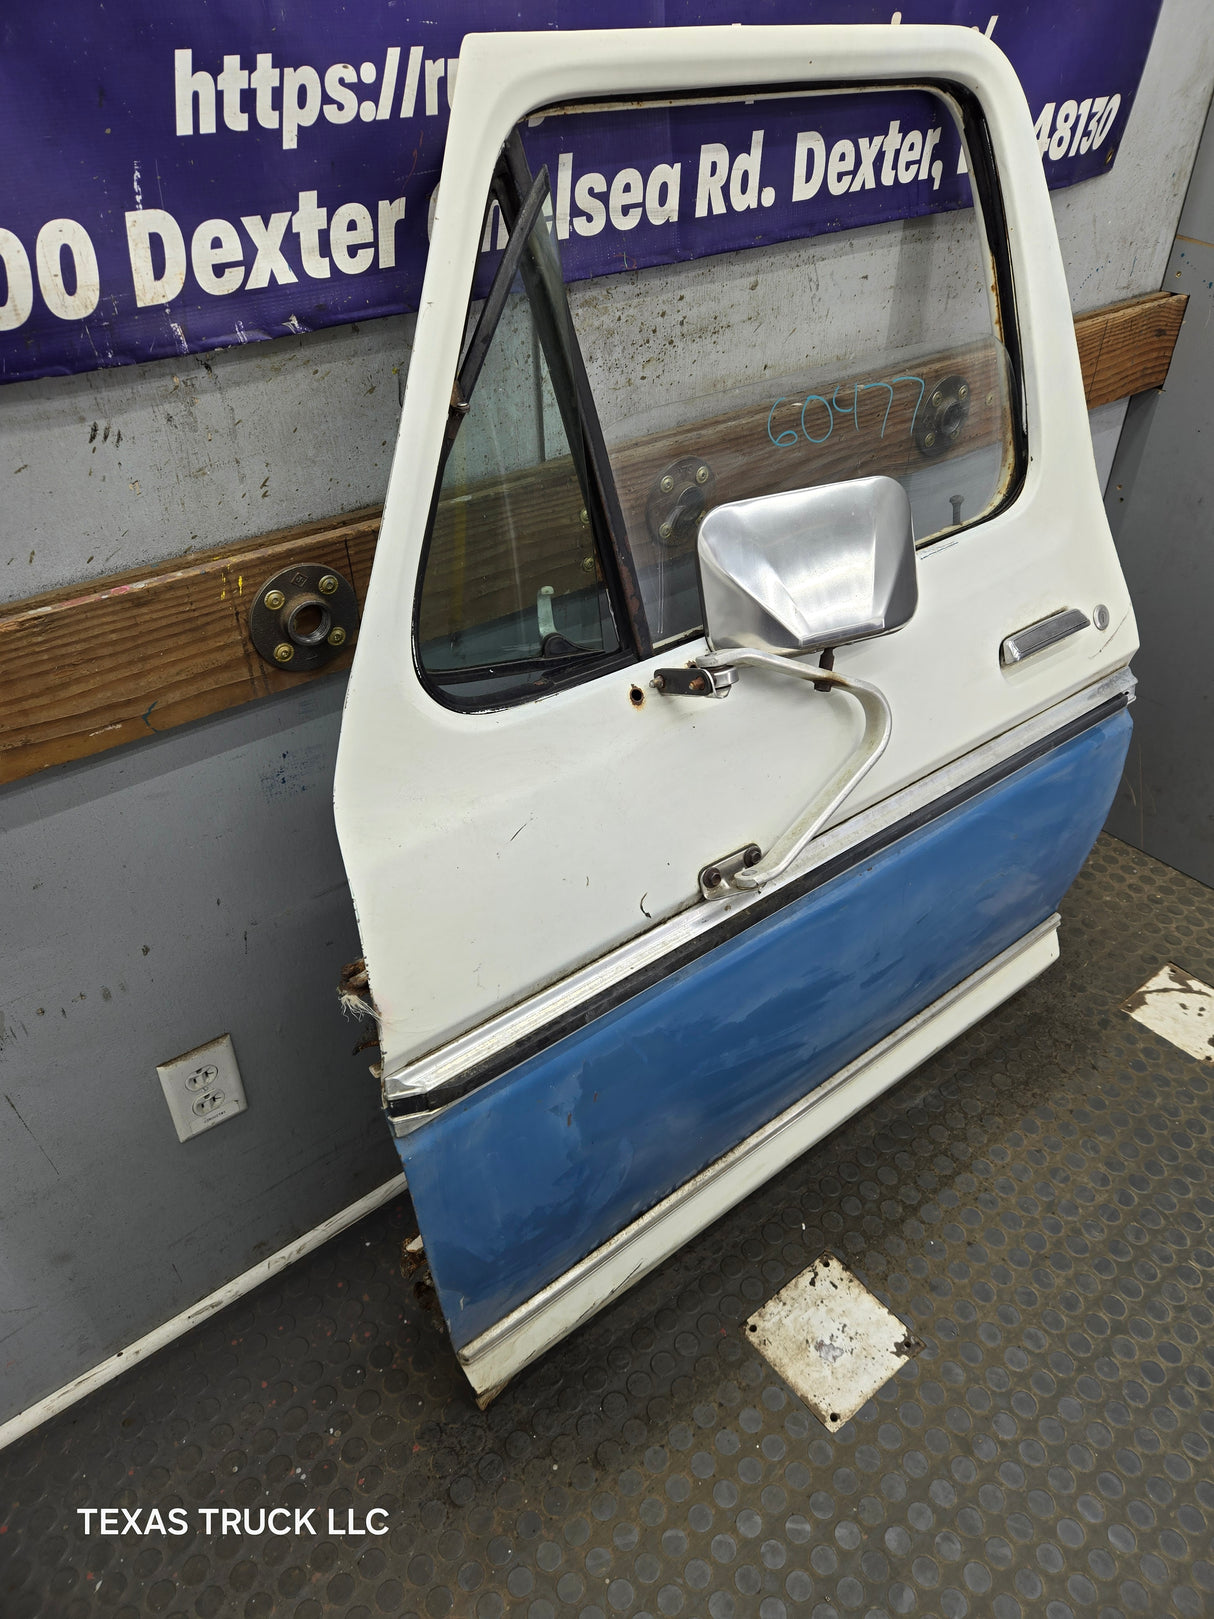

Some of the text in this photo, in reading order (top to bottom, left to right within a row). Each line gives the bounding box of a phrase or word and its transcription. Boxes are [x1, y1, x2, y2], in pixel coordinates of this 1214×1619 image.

[124, 190, 406, 308] Dexter
[695, 130, 776, 219] Rd.
[792, 119, 943, 203] Dexter,
[1034, 93, 1122, 161] 48130
[767, 376, 925, 447] 60477
